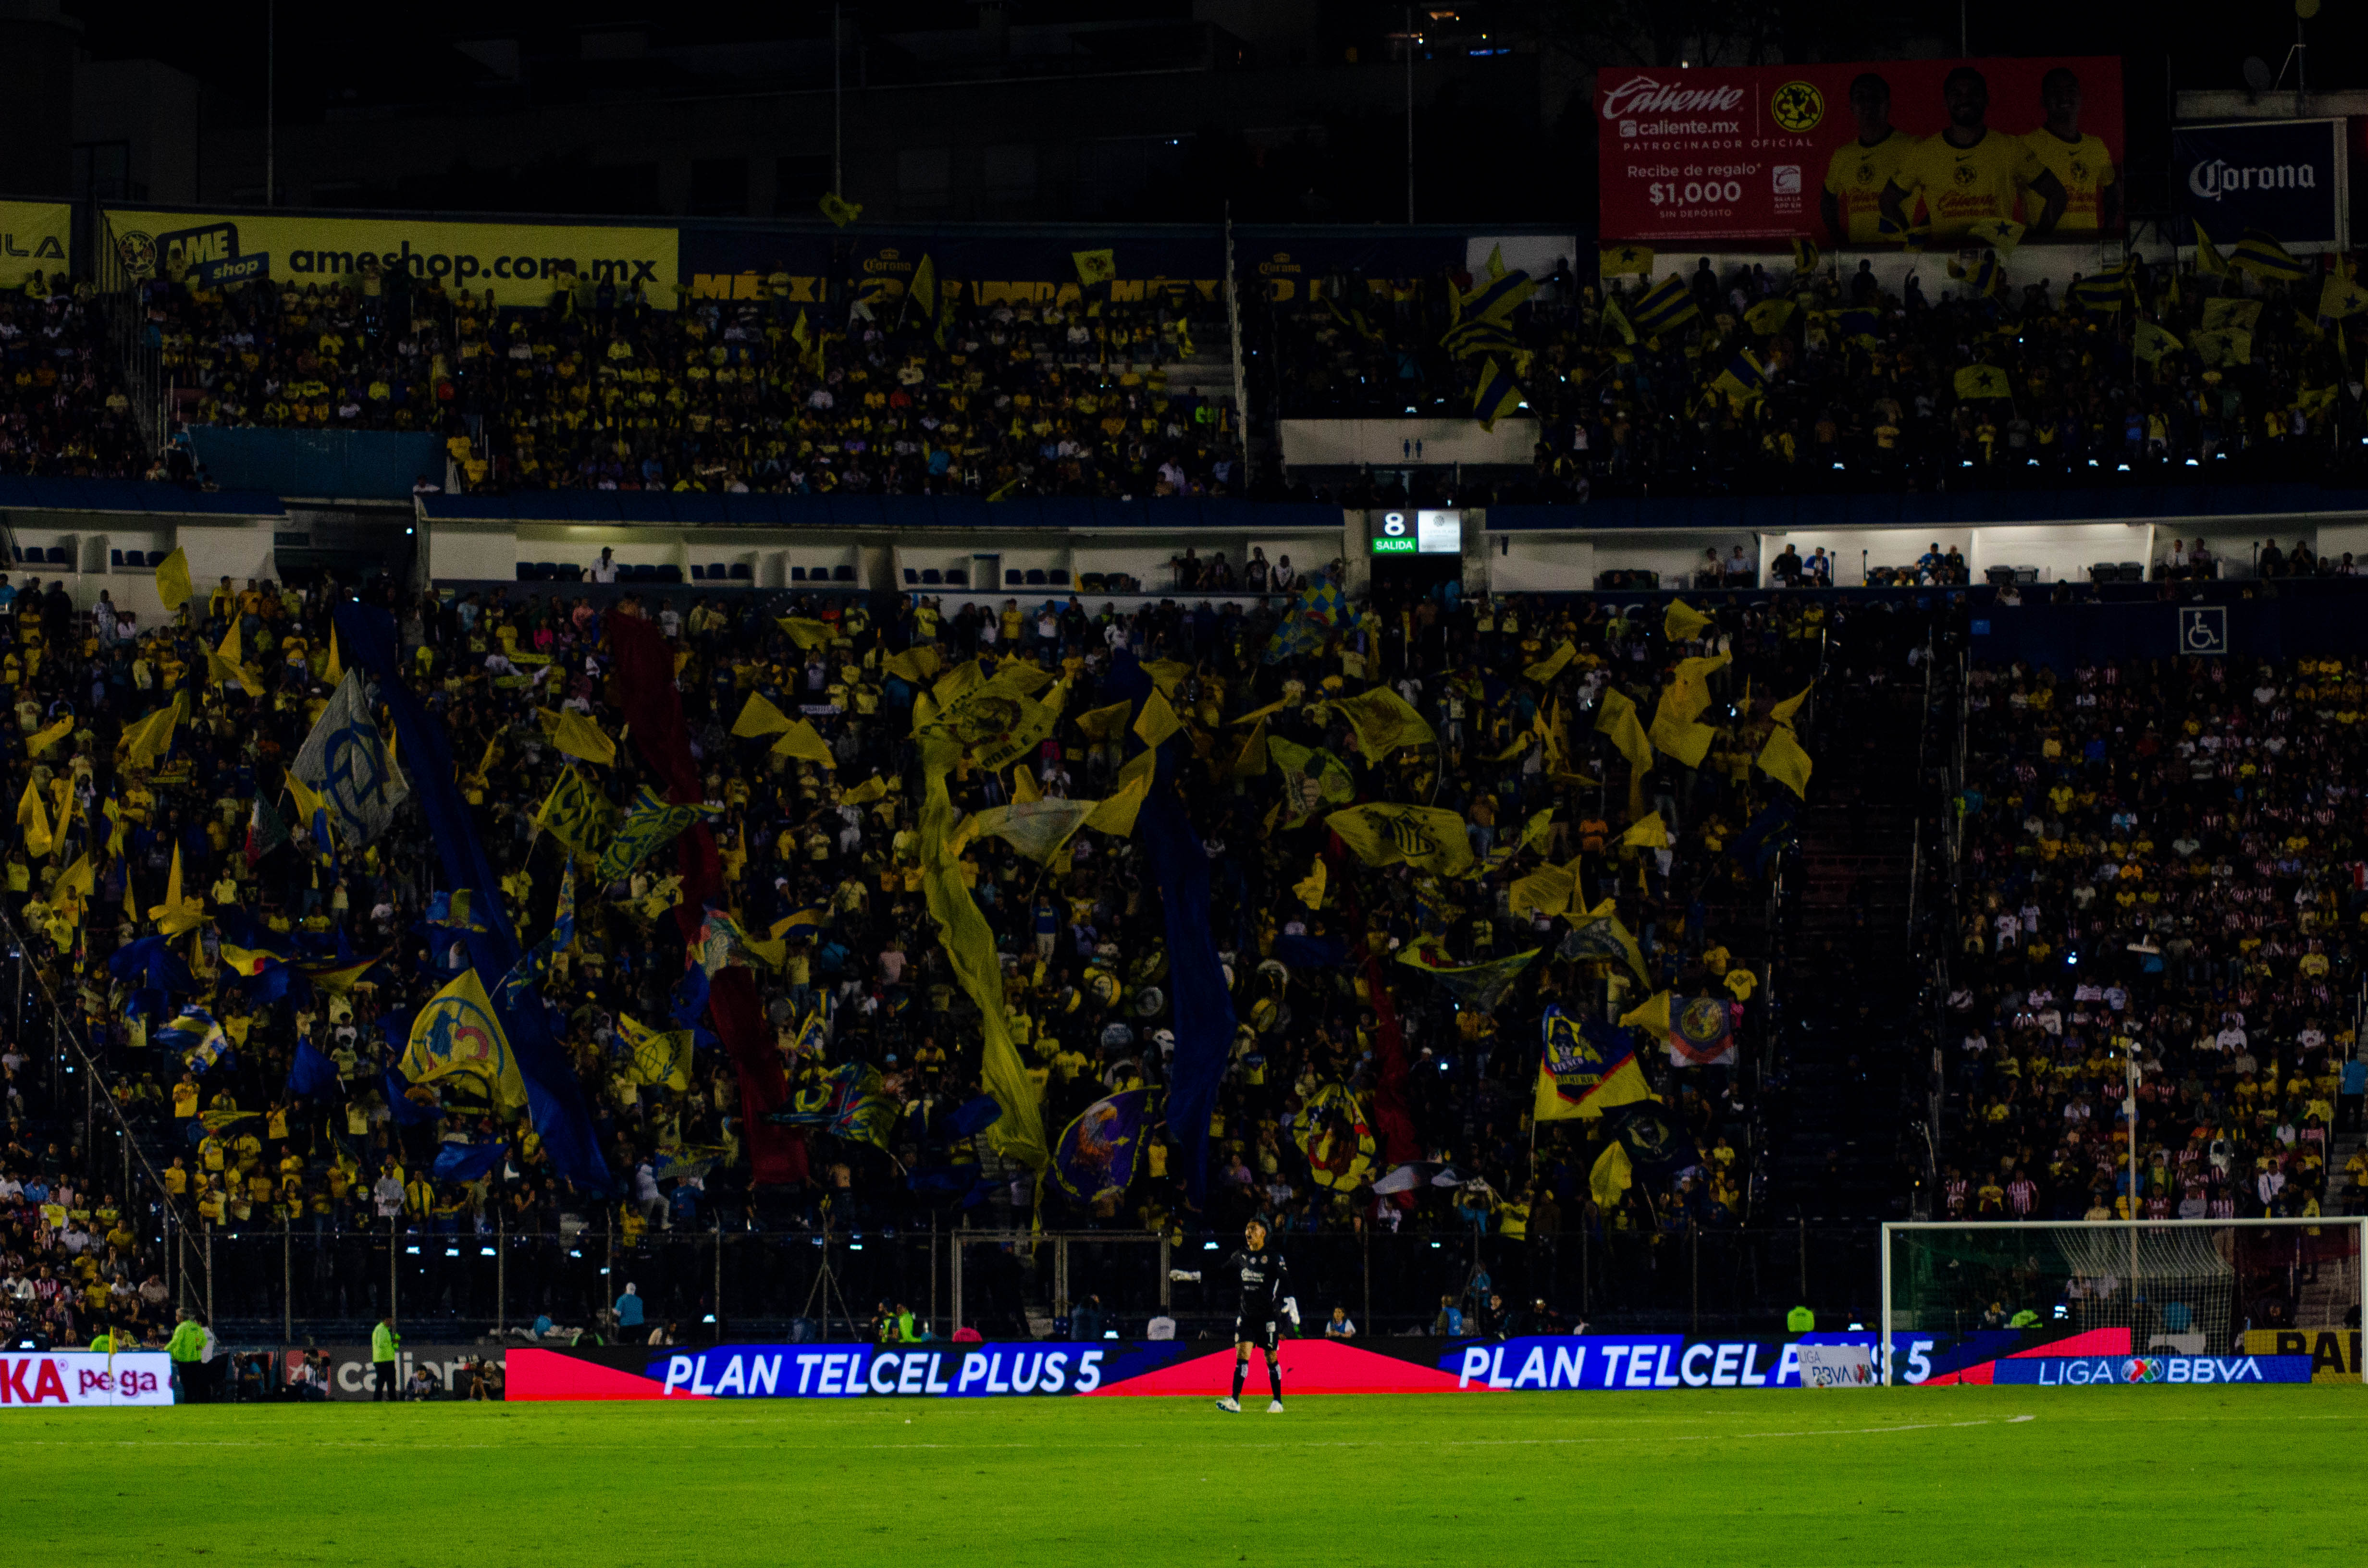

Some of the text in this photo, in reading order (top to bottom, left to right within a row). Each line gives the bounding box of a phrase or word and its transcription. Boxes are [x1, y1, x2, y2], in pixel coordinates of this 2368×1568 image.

[1602, 75, 1744, 120] Caliente
[1639, 120, 1739, 135] caliente.mx
[1623, 138, 1813, 151] PATROCINADOR OFICIAL
[1628, 165, 1679, 178] Recibe
[1684, 164, 1703, 176] de
[2188, 158, 2316, 202] Corona
[1649, 181, 1742, 207] $1,000
[1659, 210, 1676, 219] SIN
[0, 233, 65, 259] LA
[166, 229, 230, 270] AME
[212, 260, 259, 280] shop
[289, 241, 658, 287] ameshop.com.mx
[863, 257, 912, 274] Corona
[1258, 261, 1301, 276] Corona
[1384, 512, 1406, 536] 8
[1376, 541, 1413, 551] SALIDA
[1459, 1347, 1598, 1387] PLAN
[1601, 1344, 1765, 1387] TELCEL
[1903, 1340, 1934, 1384] 5
[1798, 1350, 1821, 1364] LIGA
[79, 1369, 157, 1396] pega
[664, 1350, 1103, 1395] PLAN TELCEL PLUS 5
[2038, 1356, 2263, 1386] LIGA BBVA
